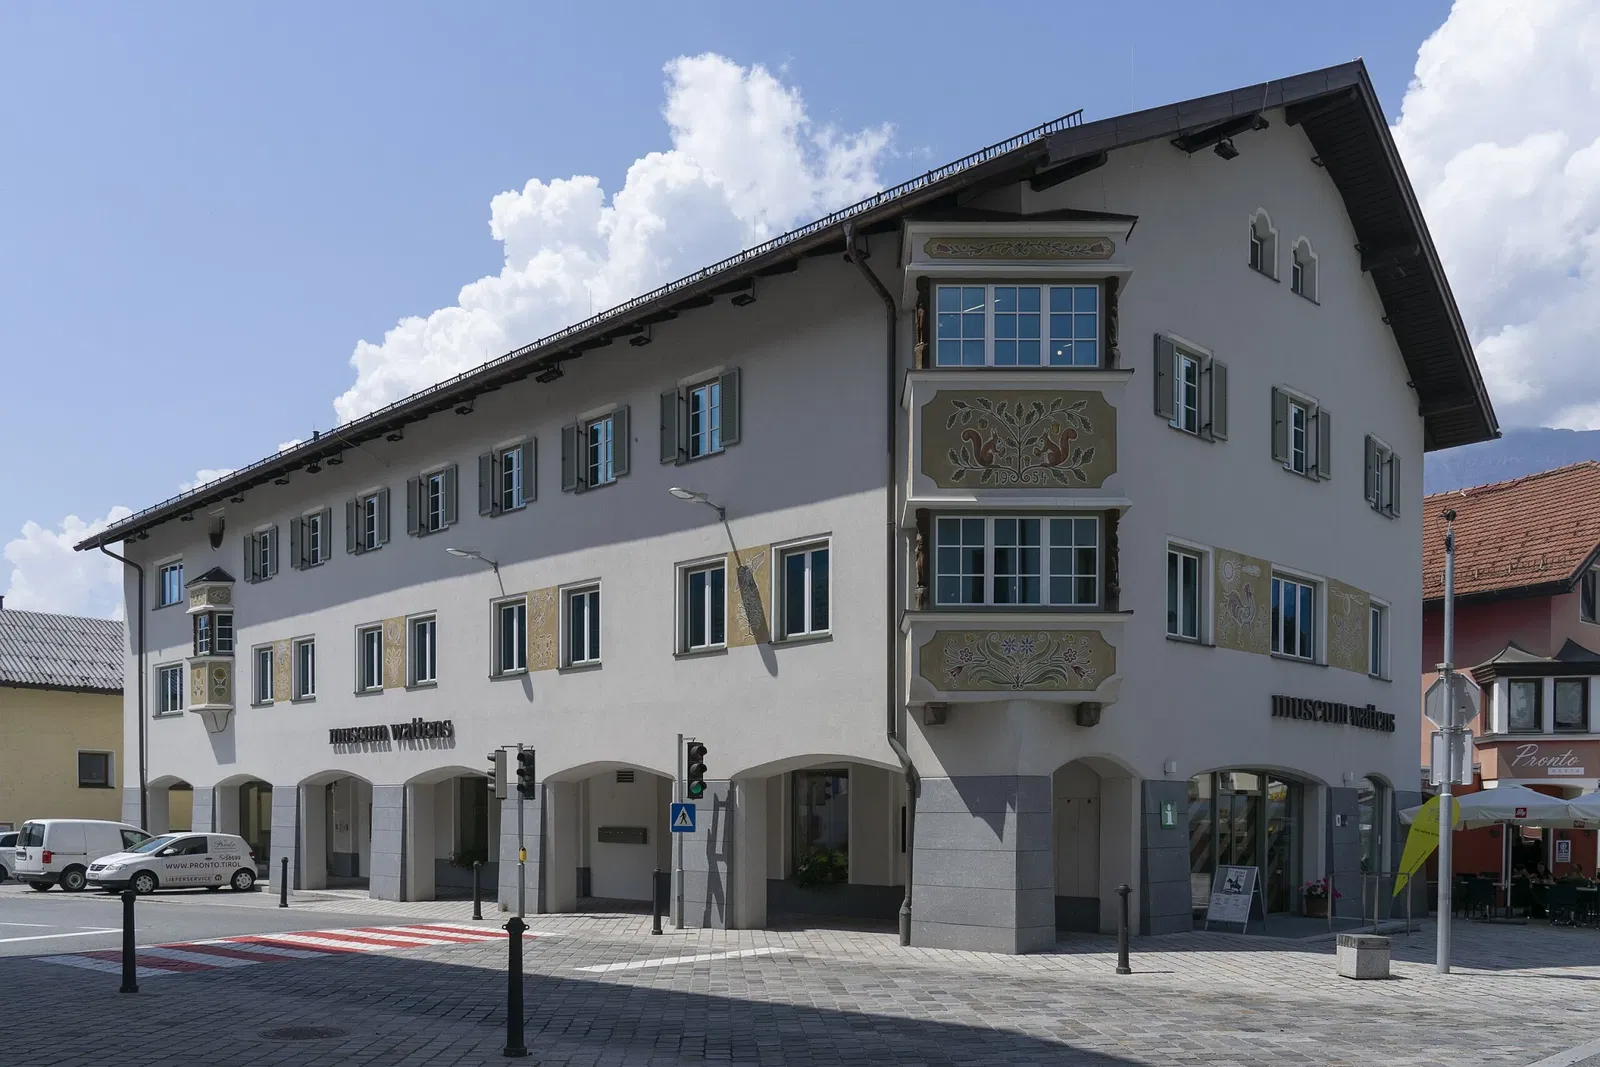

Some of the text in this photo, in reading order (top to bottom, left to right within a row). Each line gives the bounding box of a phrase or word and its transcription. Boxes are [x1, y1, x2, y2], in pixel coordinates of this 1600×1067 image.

[994, 470, 1049, 485] 19 54
[1271, 694, 1396, 733] museum wattens
[328, 717, 452, 744] museum wattens
[1512, 743, 1579, 767] Pronto
[165, 861, 242, 869] WWW.PRONTO.TIROL
